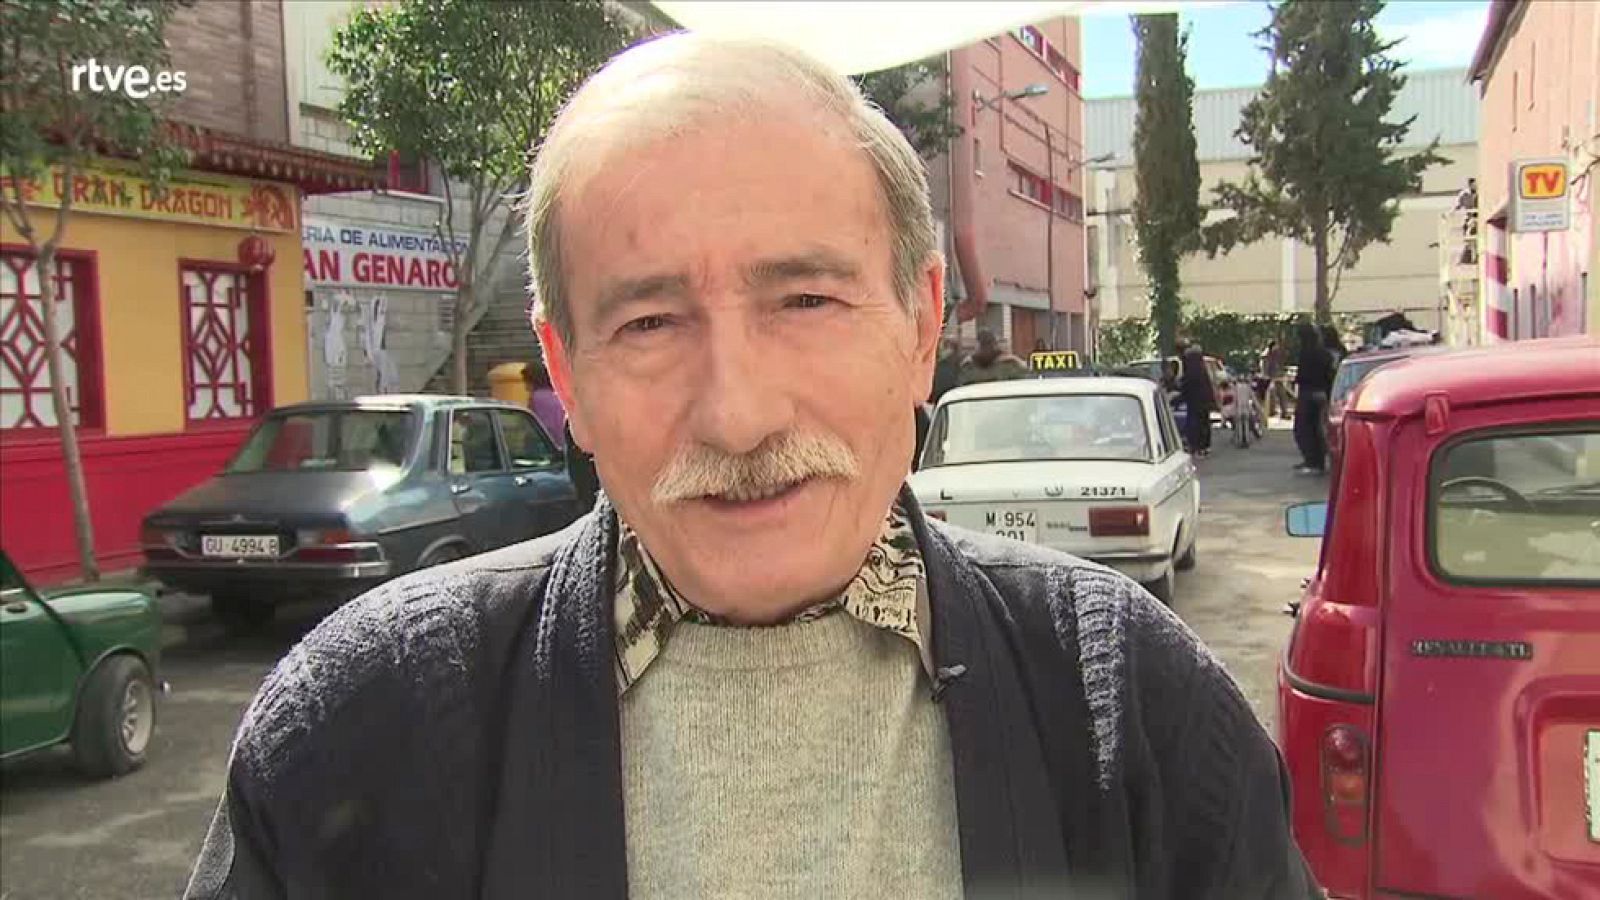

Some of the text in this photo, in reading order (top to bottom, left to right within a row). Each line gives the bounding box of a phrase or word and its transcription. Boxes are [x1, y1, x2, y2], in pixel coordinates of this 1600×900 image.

[1525, 170, 1560, 194] TV
[340, 229, 363, 245] DE
[1034, 352, 1073, 369] TAXI
[1080, 486, 1125, 496] 21371
